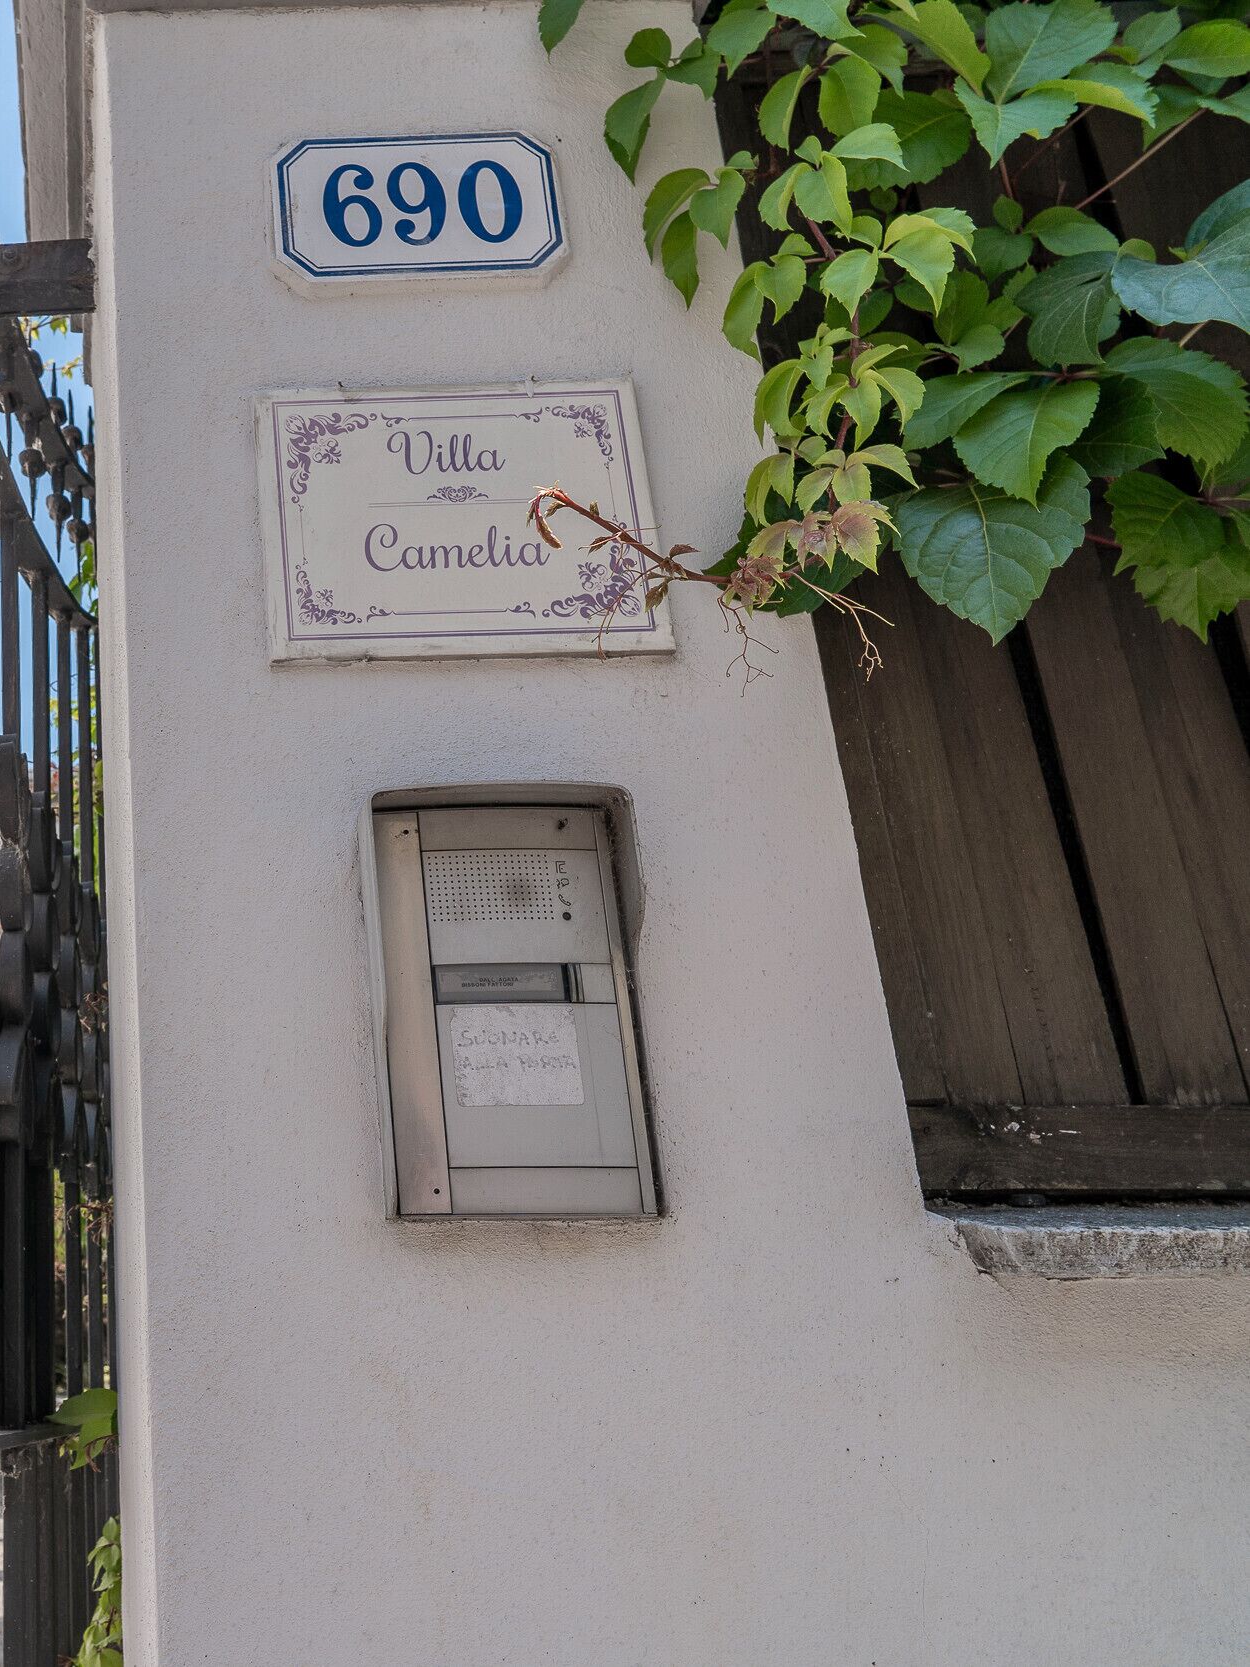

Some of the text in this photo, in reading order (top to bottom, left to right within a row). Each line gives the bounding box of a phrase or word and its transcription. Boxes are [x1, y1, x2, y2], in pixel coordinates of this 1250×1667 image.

[322, 160, 523, 247] 690
[386, 430, 506, 475] Villa
[364, 523, 550, 572] Camelia
